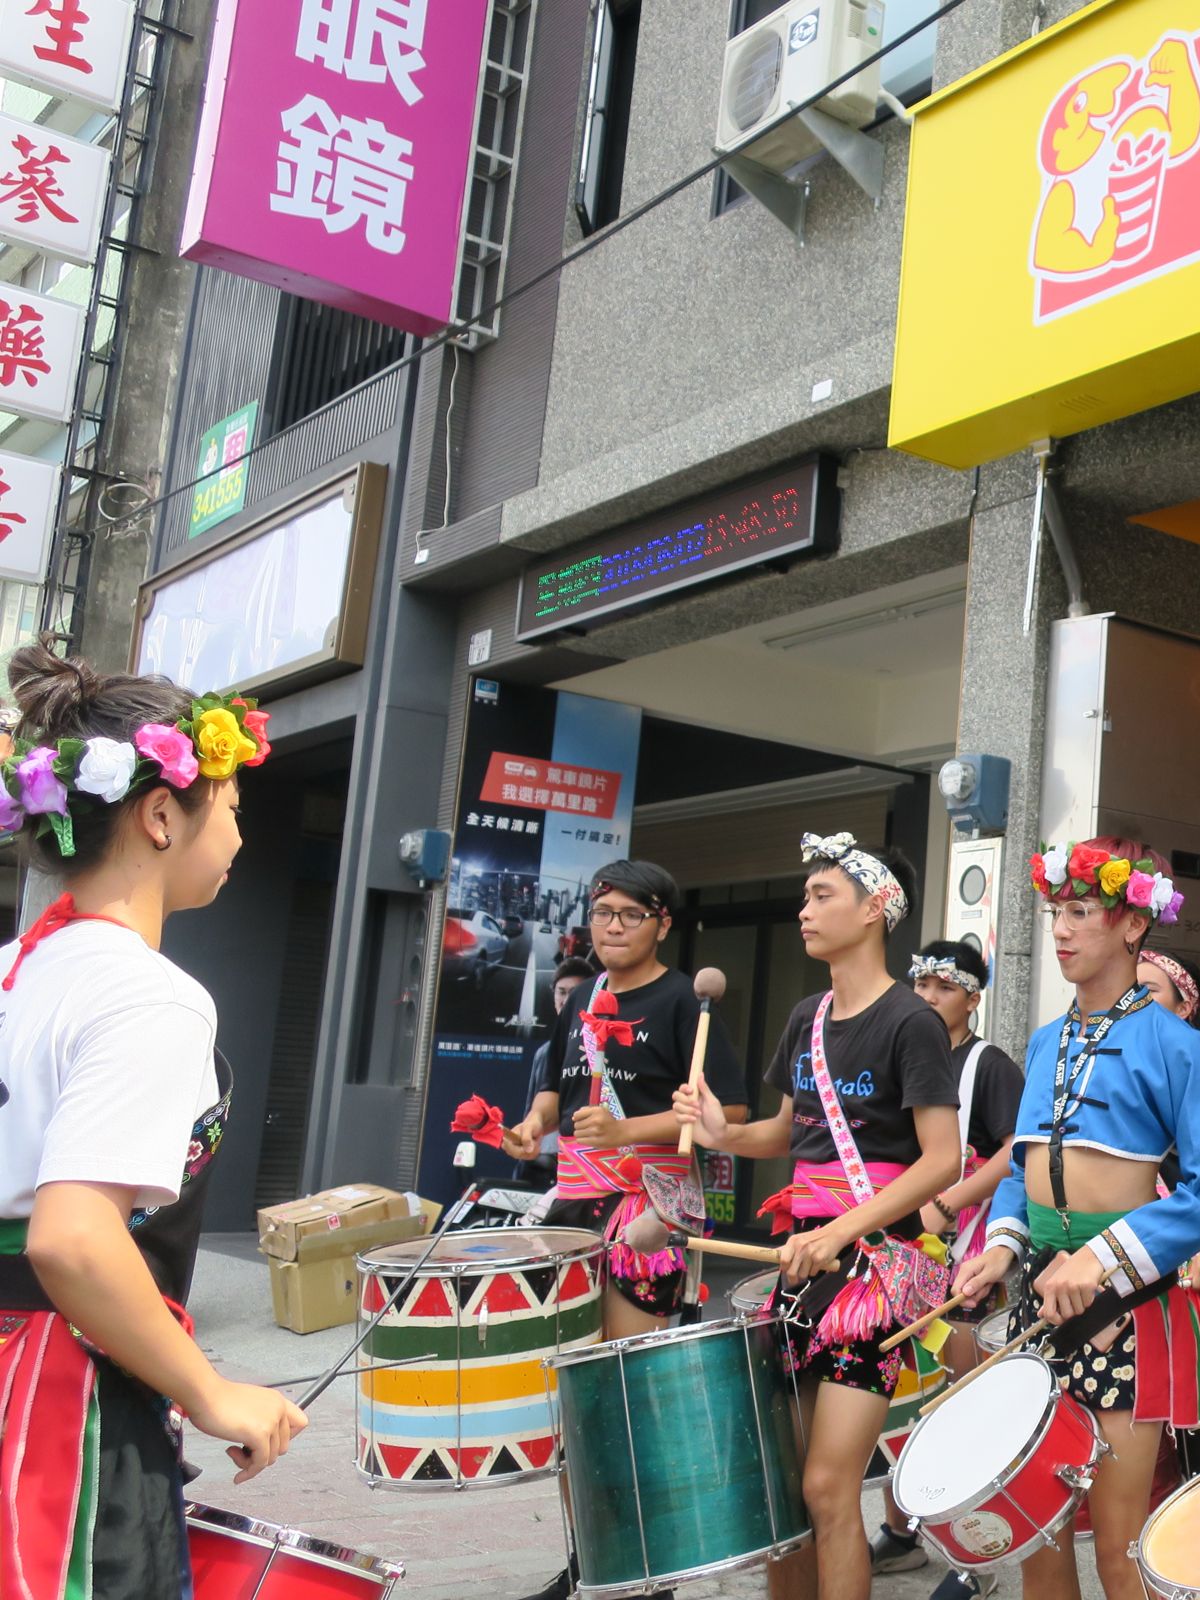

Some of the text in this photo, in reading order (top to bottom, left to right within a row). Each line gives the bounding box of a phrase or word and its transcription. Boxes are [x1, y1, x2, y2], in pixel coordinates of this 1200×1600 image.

[270, 0, 427, 255] 眼鏡
[192, 467, 244, 522] 341555
[466, 812, 540, 835] 全天候清晰
[1115, 987, 1138, 1011] VANS
[1060, 1021, 1072, 1049] VANS
[1090, 1016, 1114, 1042] VANS
[1055, 1057, 1066, 1087] VANS
[1069, 1052, 1089, 1080] VANS
